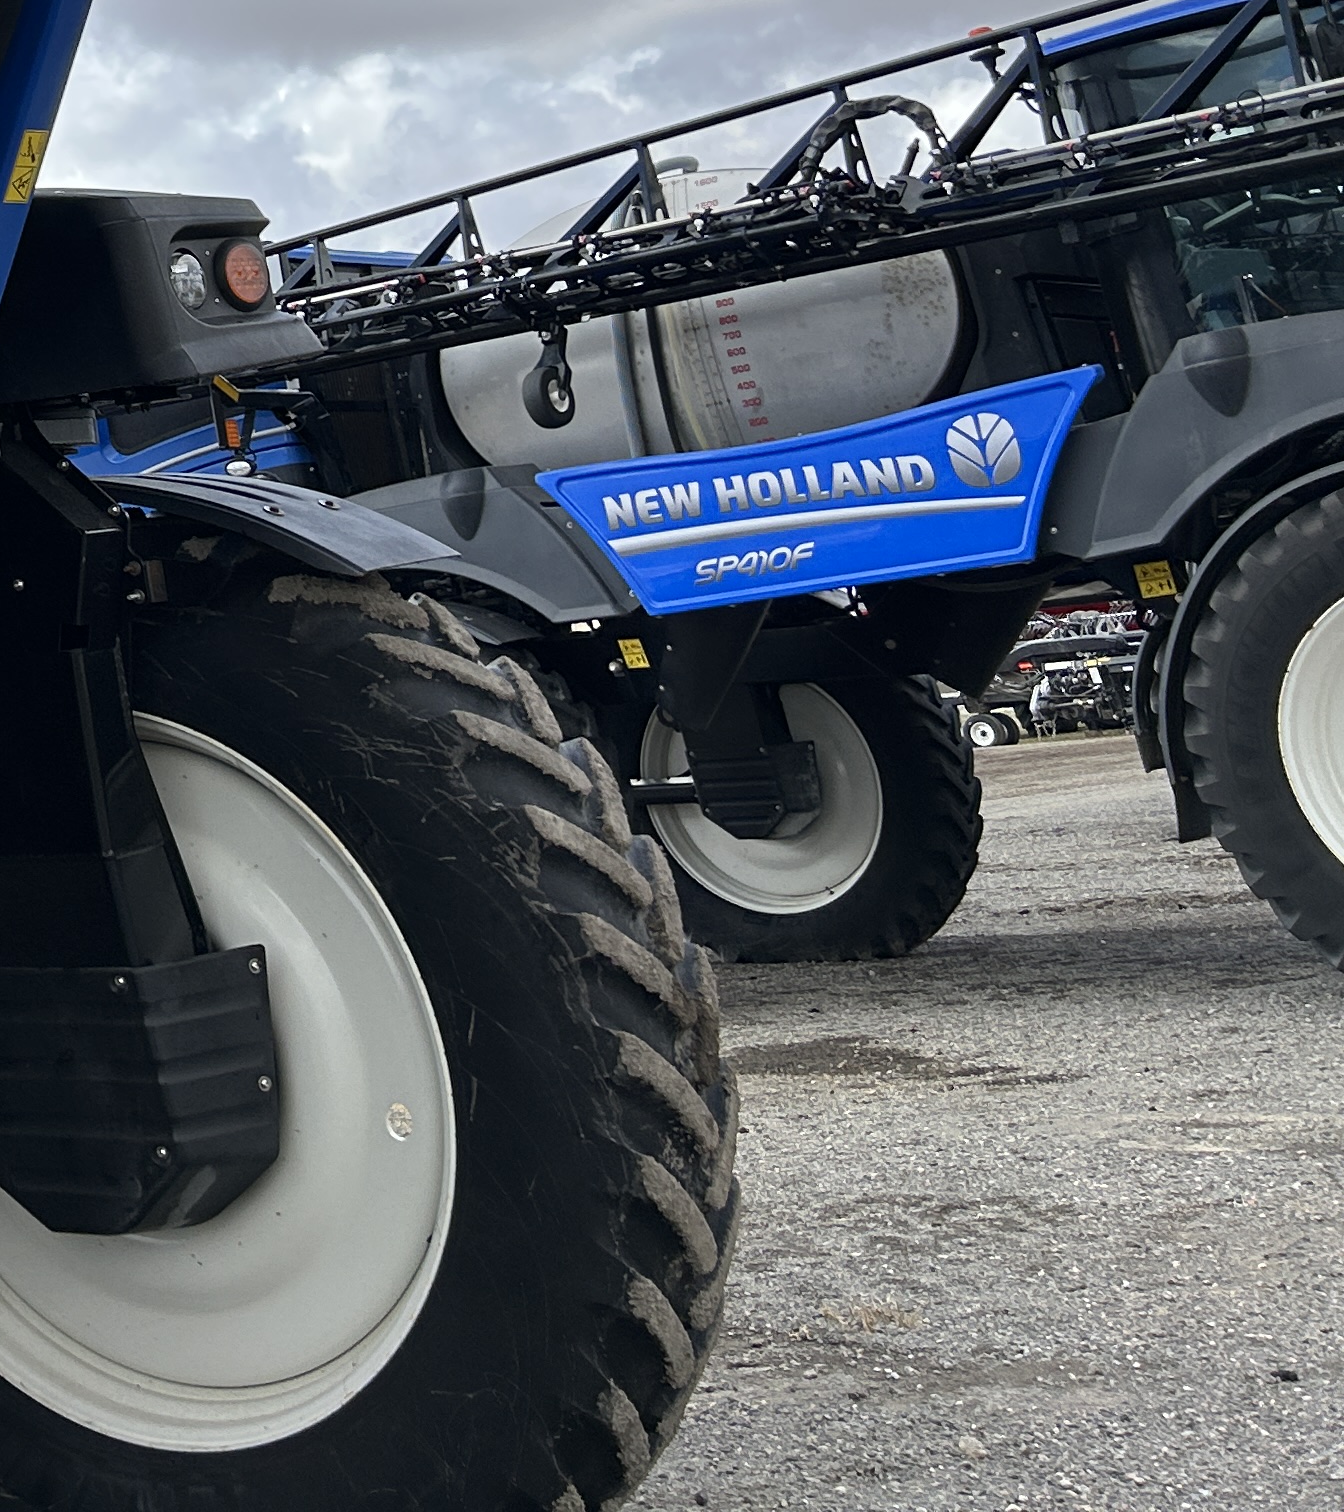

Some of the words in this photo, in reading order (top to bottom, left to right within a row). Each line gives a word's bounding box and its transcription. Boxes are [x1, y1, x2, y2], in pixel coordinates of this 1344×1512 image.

[715, 297, 735, 308] 900
[719, 314, 738, 325] 800
[722, 330, 742, 340] 700
[726, 347, 746, 357] 600
[731, 364, 751, 375] 500
[737, 380, 756, 390] 400
[742, 397, 762, 408] 300
[602, 481, 701, 531] NEW
[713, 455, 935, 512] HOLLAND
[694, 541, 815, 586] SP410F
